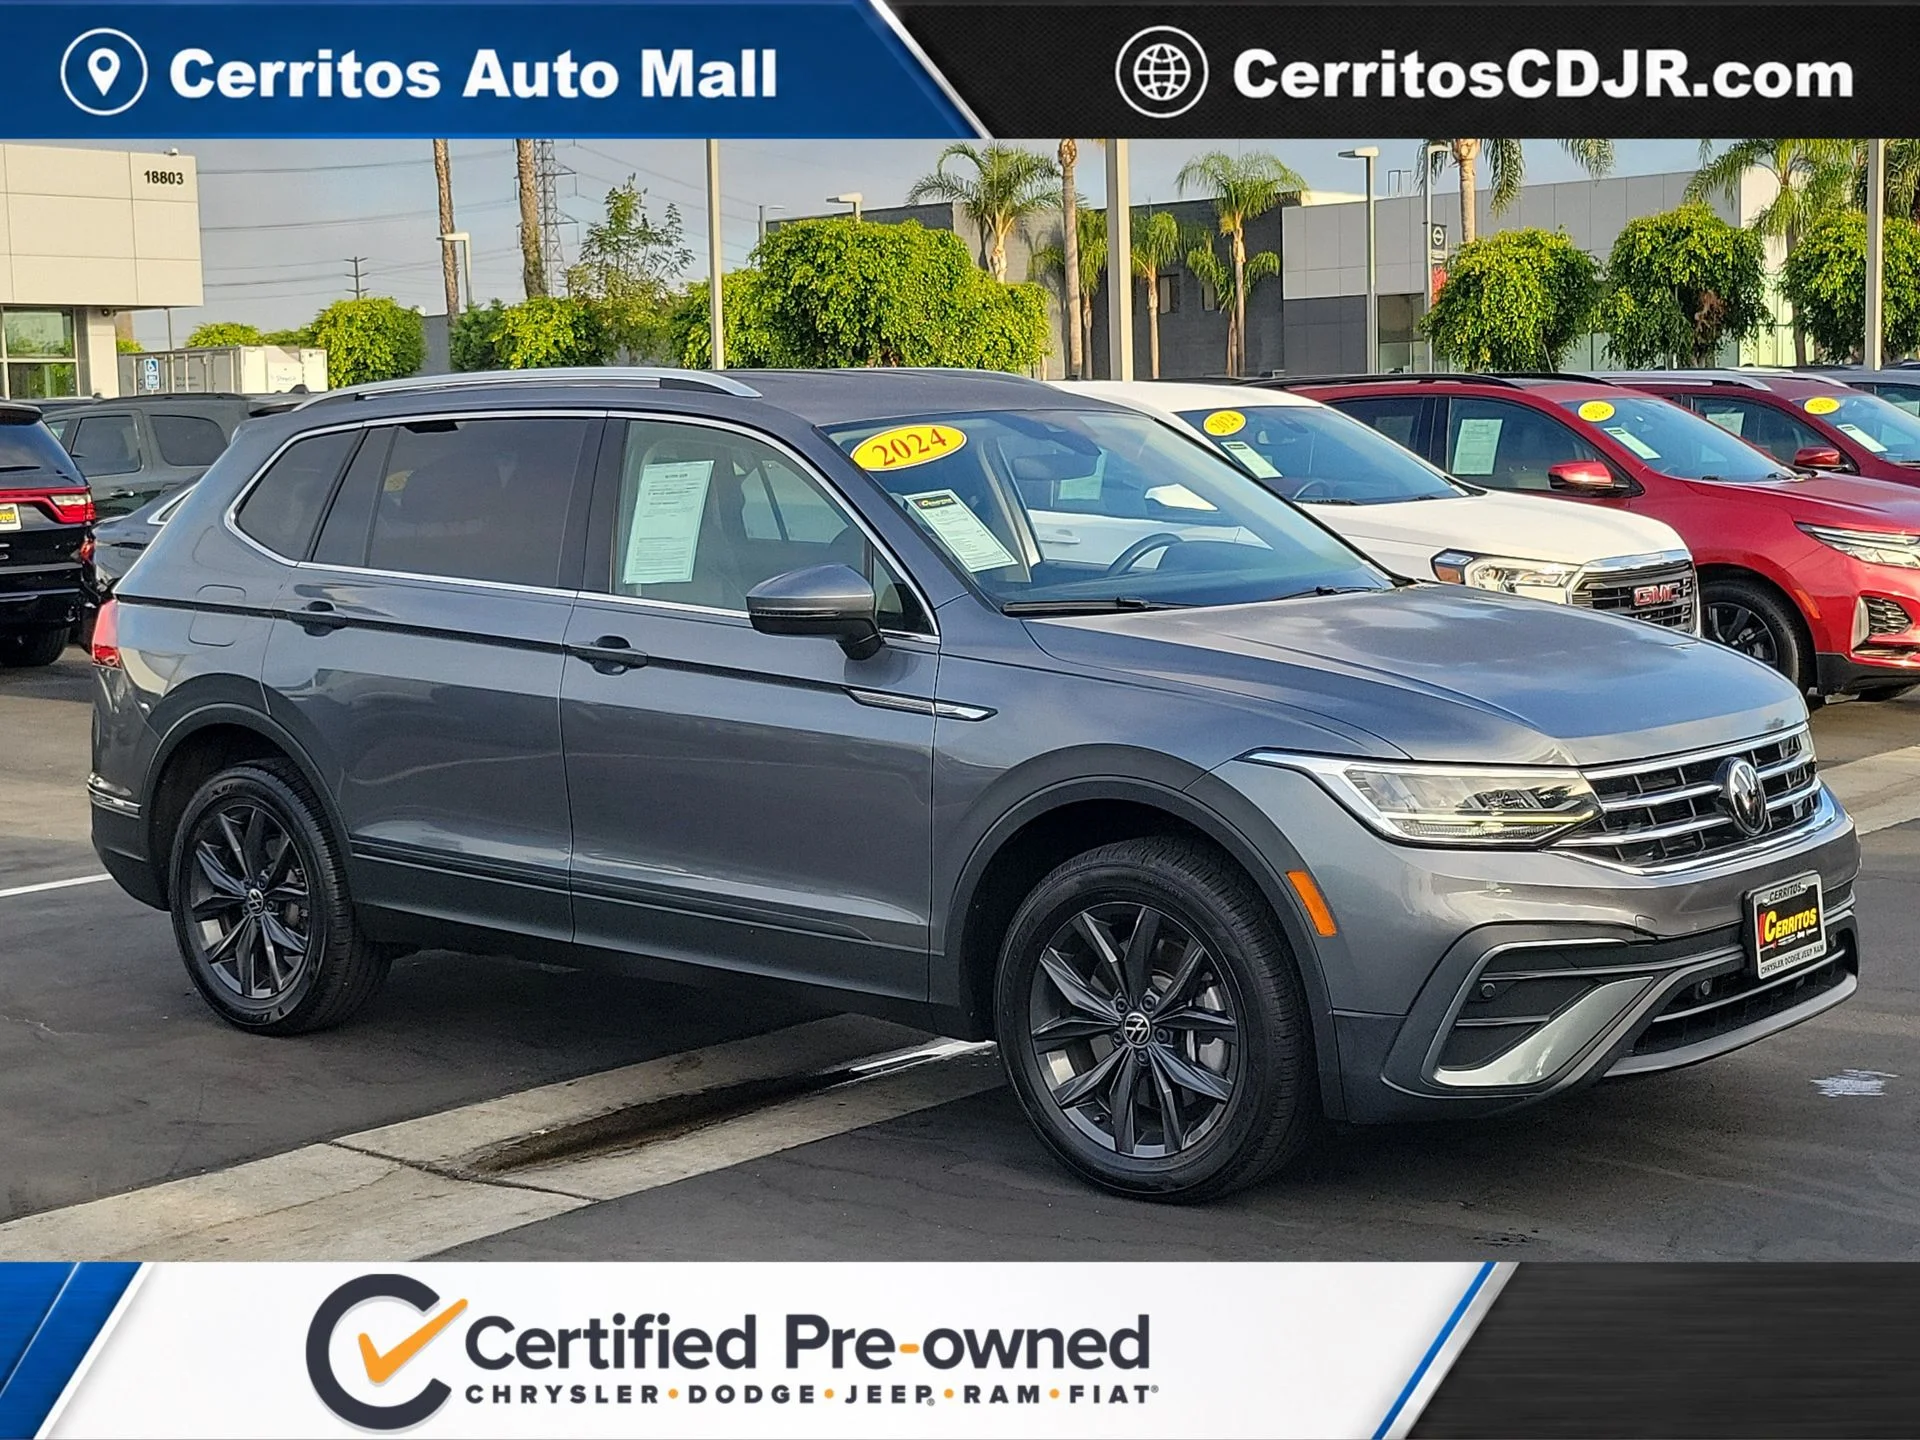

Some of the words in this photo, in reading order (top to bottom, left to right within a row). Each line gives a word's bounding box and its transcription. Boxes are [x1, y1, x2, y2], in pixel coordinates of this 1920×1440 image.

[144, 169, 184, 185] 18803
[872, 428, 947, 467] 2024
[1634, 582, 1681, 607] GMC
[1769, 882, 1802, 902] CERRITOS
